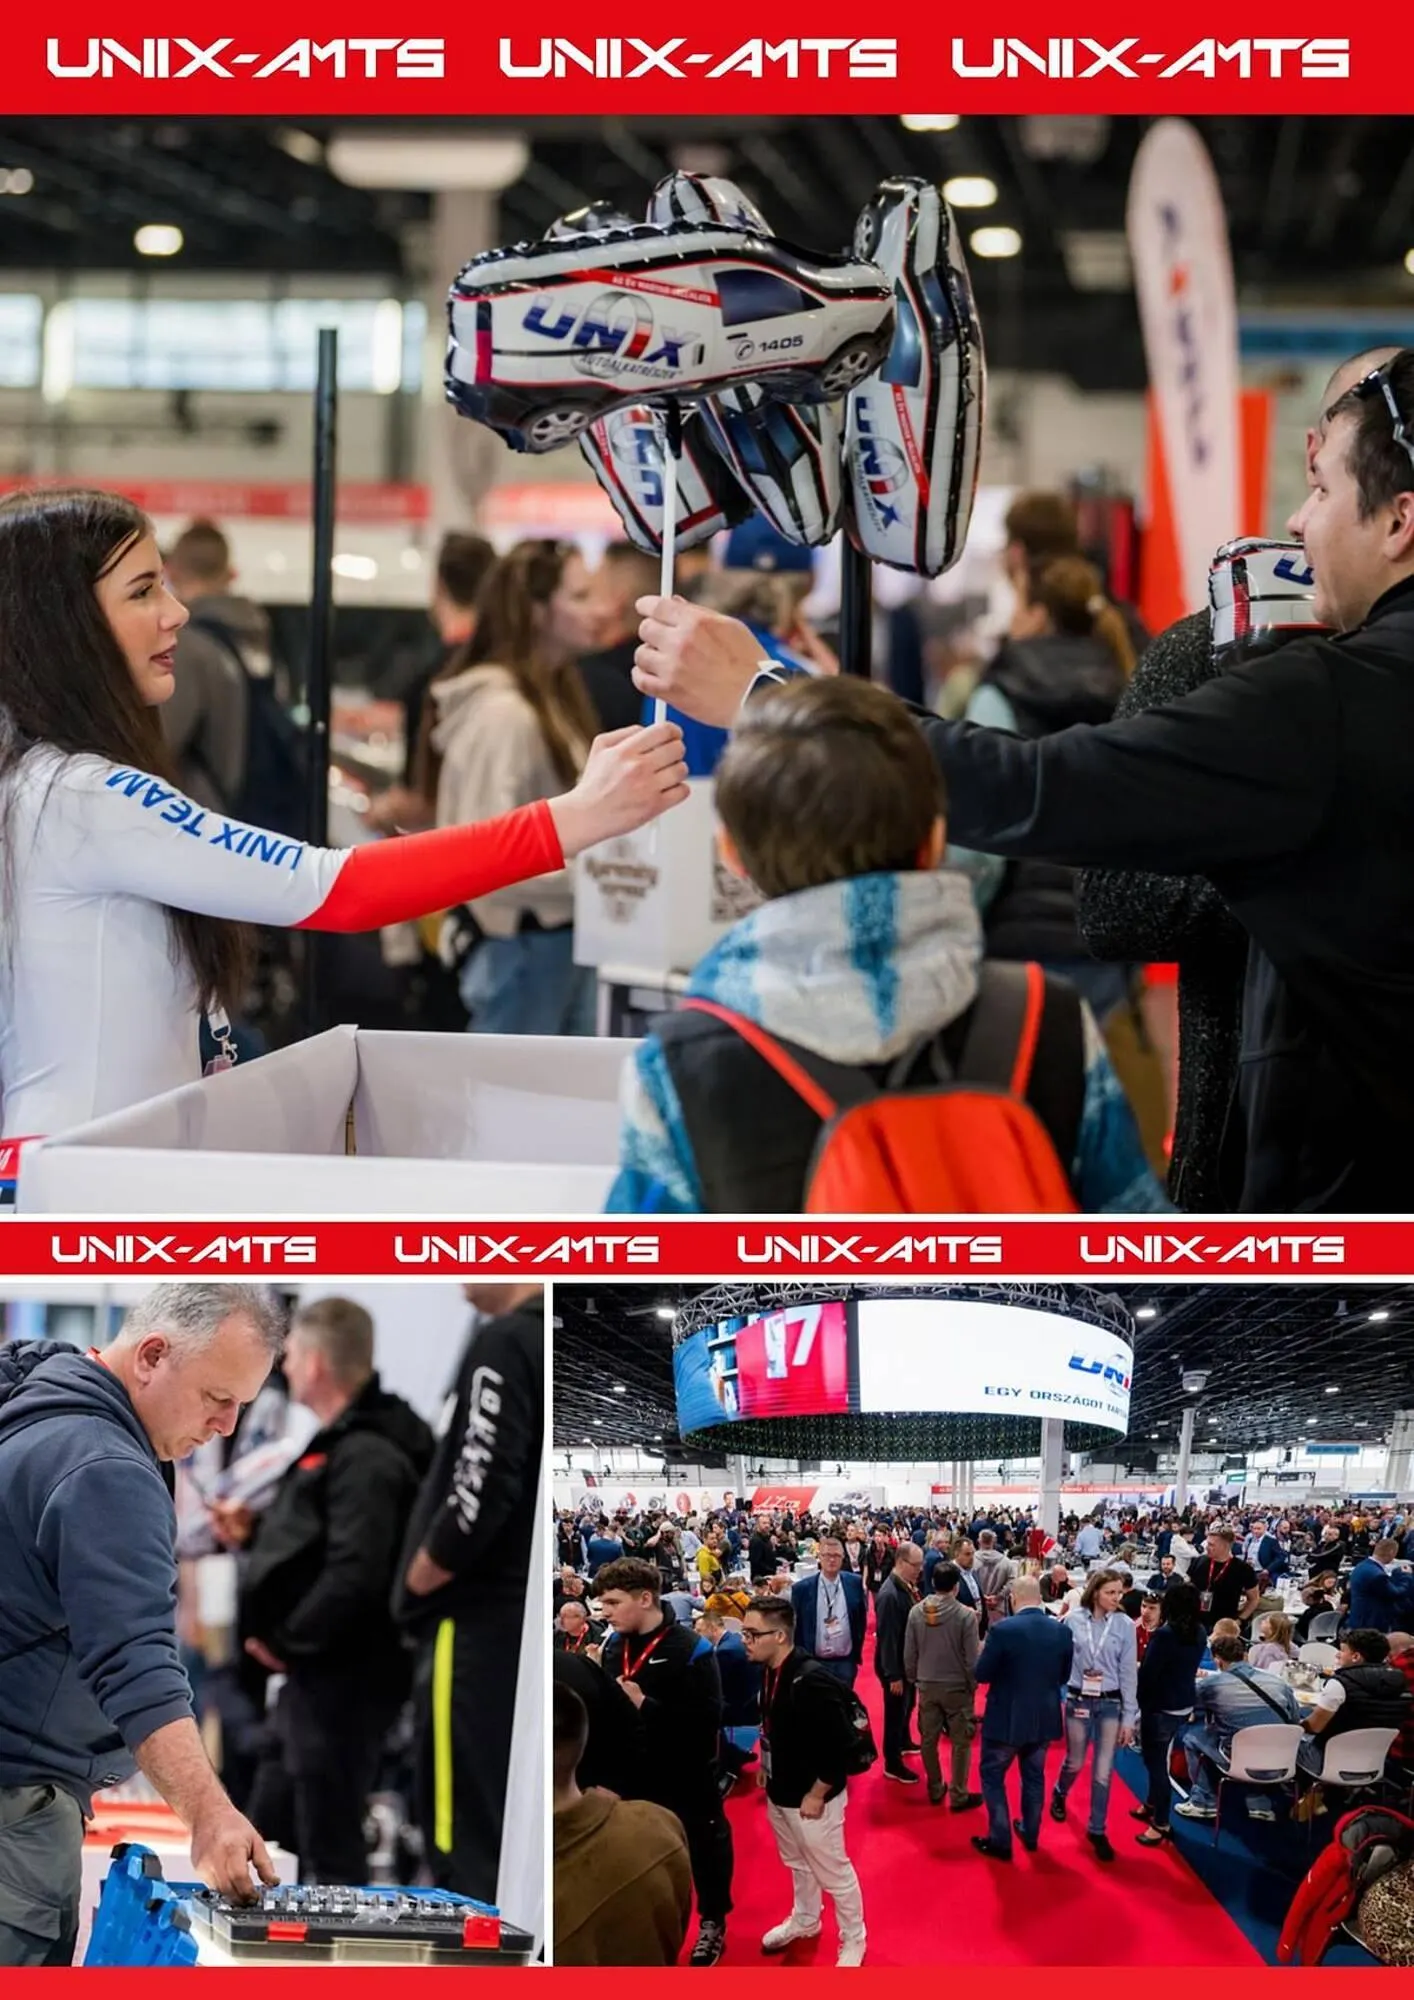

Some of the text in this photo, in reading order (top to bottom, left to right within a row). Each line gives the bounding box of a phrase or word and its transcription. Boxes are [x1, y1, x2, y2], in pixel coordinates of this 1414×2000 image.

[522, 294, 700, 367] UNIX
[759, 334, 803, 352] 1405
[855, 396, 912, 529] UNIX
[105, 770, 303, 871] UNIX TEAM
[984, 1386, 1022, 1398] EGY
[1068, 1351, 1131, 1390] UNI
